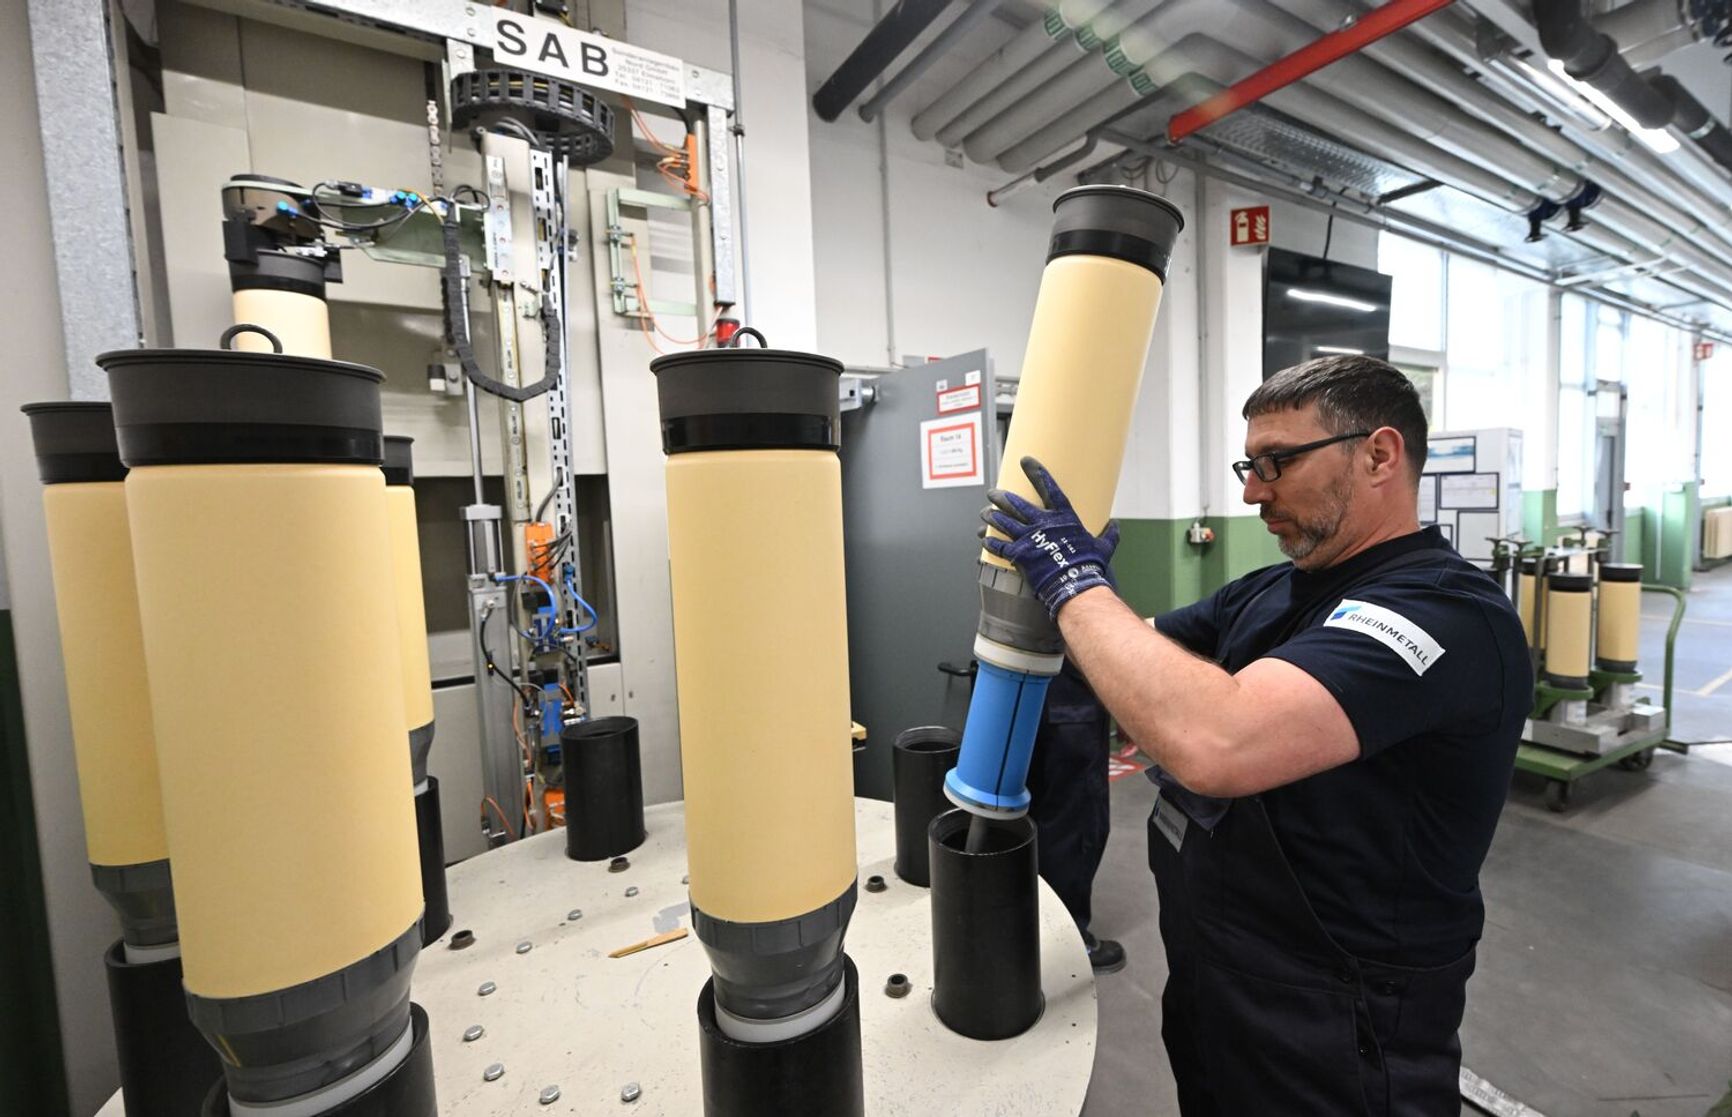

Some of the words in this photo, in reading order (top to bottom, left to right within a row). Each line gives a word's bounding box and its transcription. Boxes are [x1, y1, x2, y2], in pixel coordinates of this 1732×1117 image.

[497, 19, 609, 77] SAB
[1031, 530, 1070, 569] HyFlex
[1348, 612, 1430, 666] RHEINMETALL
